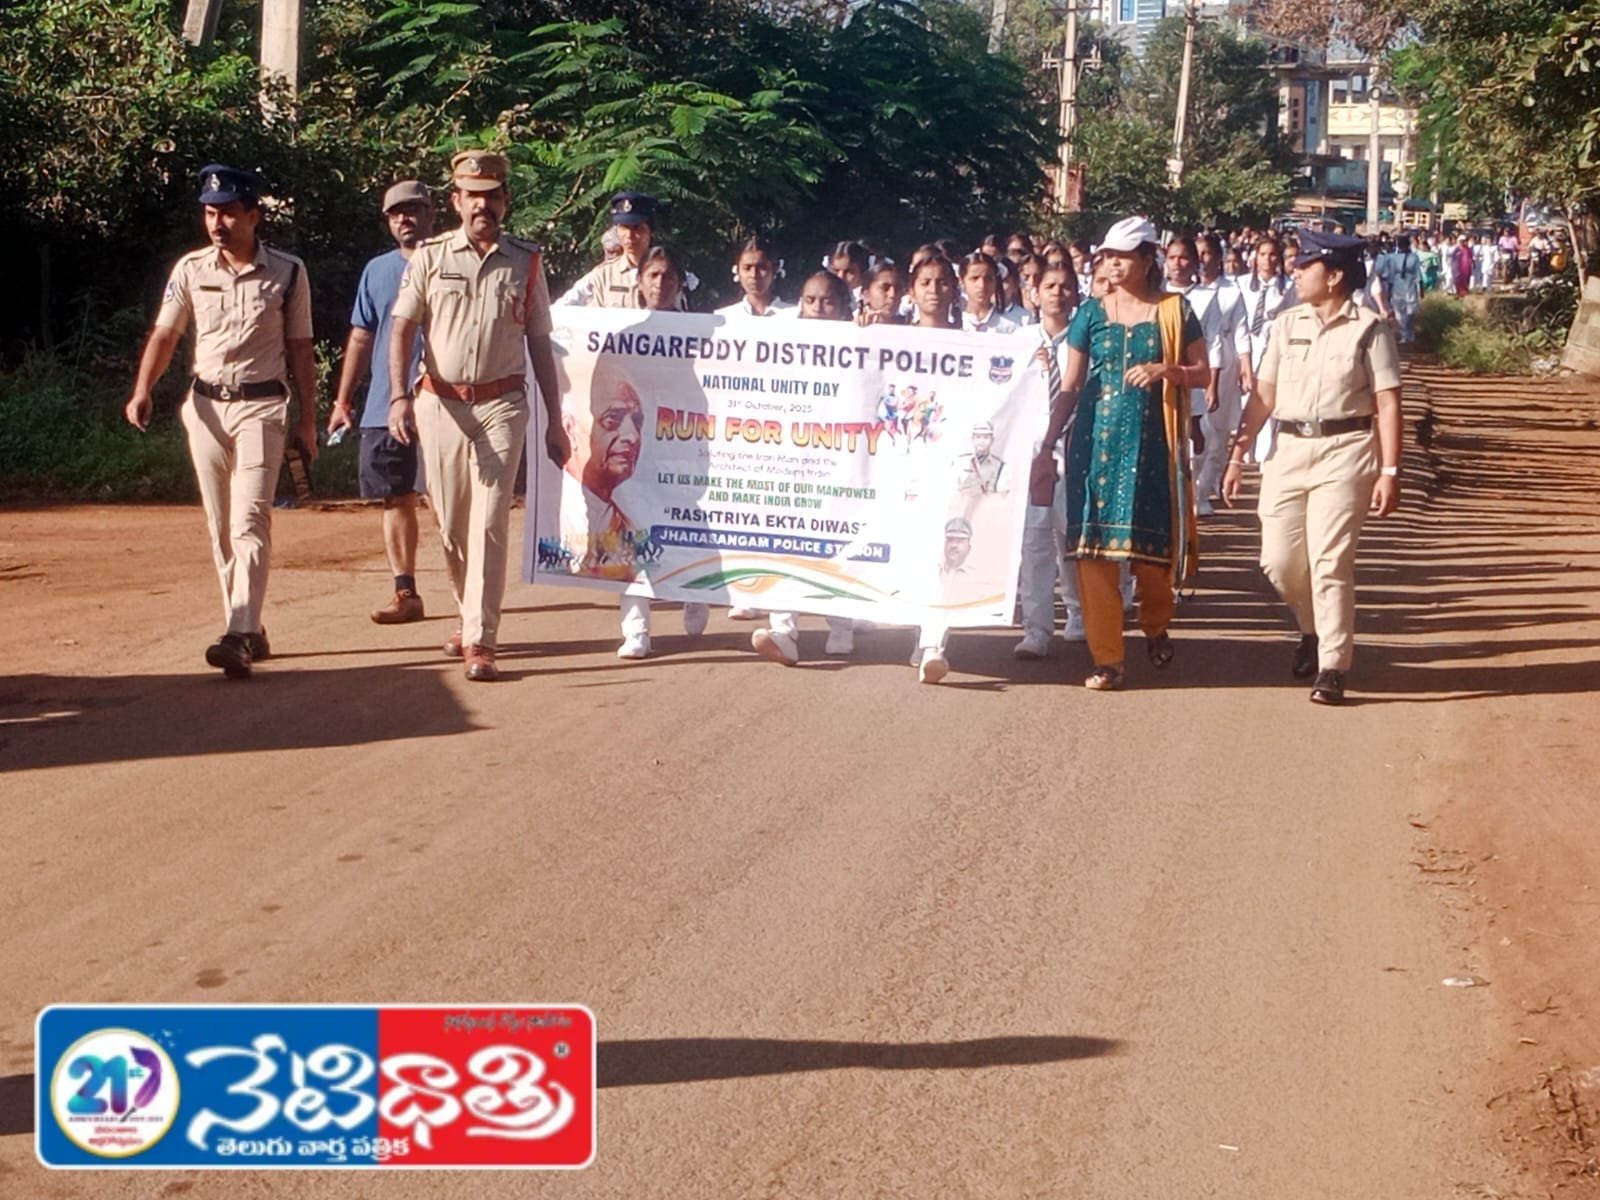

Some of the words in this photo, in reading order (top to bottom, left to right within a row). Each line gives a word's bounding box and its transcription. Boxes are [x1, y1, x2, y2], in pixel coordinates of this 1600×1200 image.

[587, 331, 747, 362] SANGAREDDY
[756, 341, 869, 369] DISTRICT
[879, 347, 974, 378] POLICE
[702, 374, 766, 393] NATIONAL
[771, 379, 809, 395] UNITY
[813, 382, 840, 397] DAY
[655, 405, 716, 442] RUN
[724, 416, 782, 445] FOR
[791, 421, 886, 456] UNITY
[657, 472, 675, 485] LET
[678, 473, 690, 486] US
[693, 474, 722, 488] MAKE
[726, 477, 744, 490] THE
[746, 478, 775, 493] MOST
[778, 481, 791, 494] OF
[793, 482, 814, 495] OUR
[816, 484, 876, 500] MANPOWER
[708, 490, 730, 503] AND
[732, 491, 761, 505] MAKE
[764, 494, 791, 508] INDIA
[794, 496, 822, 510] GROW
[766, 514, 805, 531] EKTA
[660, 531, 770, 549] JHARASANGAM
[773, 540, 821, 554] POLICE
